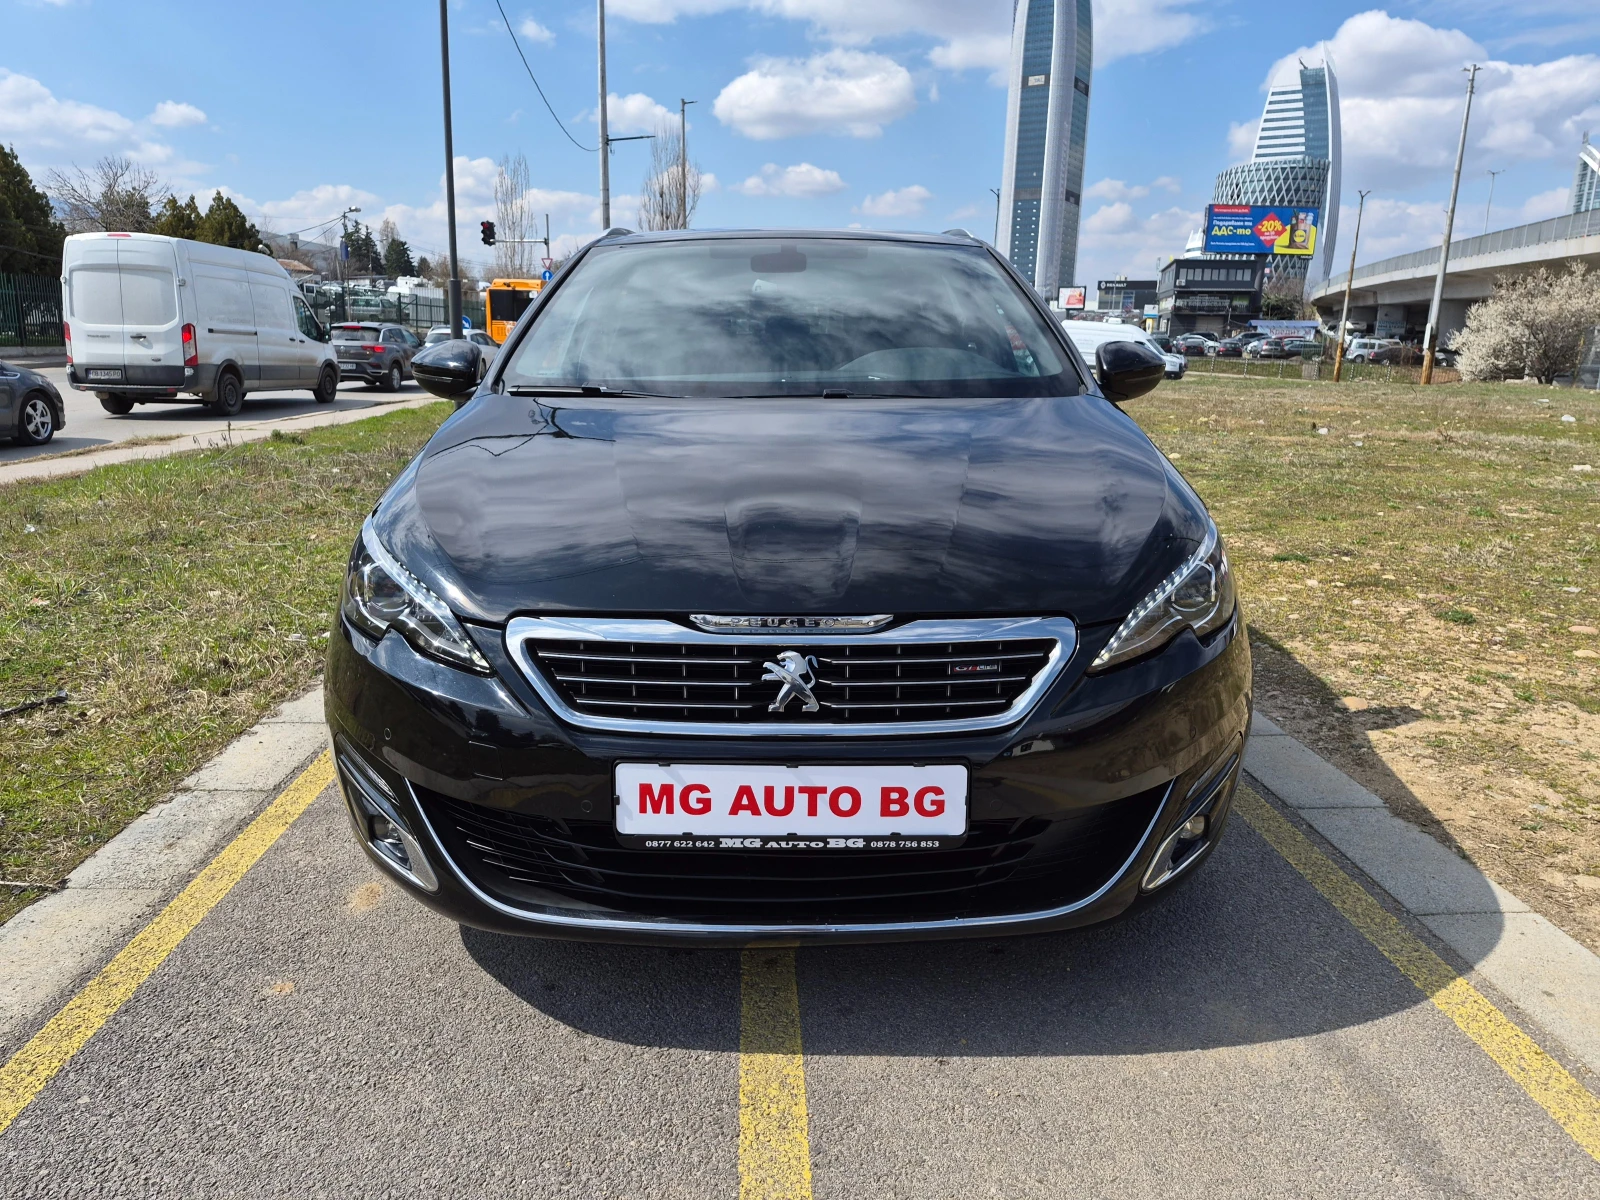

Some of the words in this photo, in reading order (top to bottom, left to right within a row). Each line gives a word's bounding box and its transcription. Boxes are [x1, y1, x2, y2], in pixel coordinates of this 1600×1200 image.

[1258, 220, 1283, 231] -20%
[1211, 226, 1252, 236] ДДС-то
[638, 783, 712, 815] MG
[728, 785, 862, 818] AUTO
[879, 786, 946, 818] BG
[719, 838, 763, 848] MG
[826, 838, 867, 848] BG
